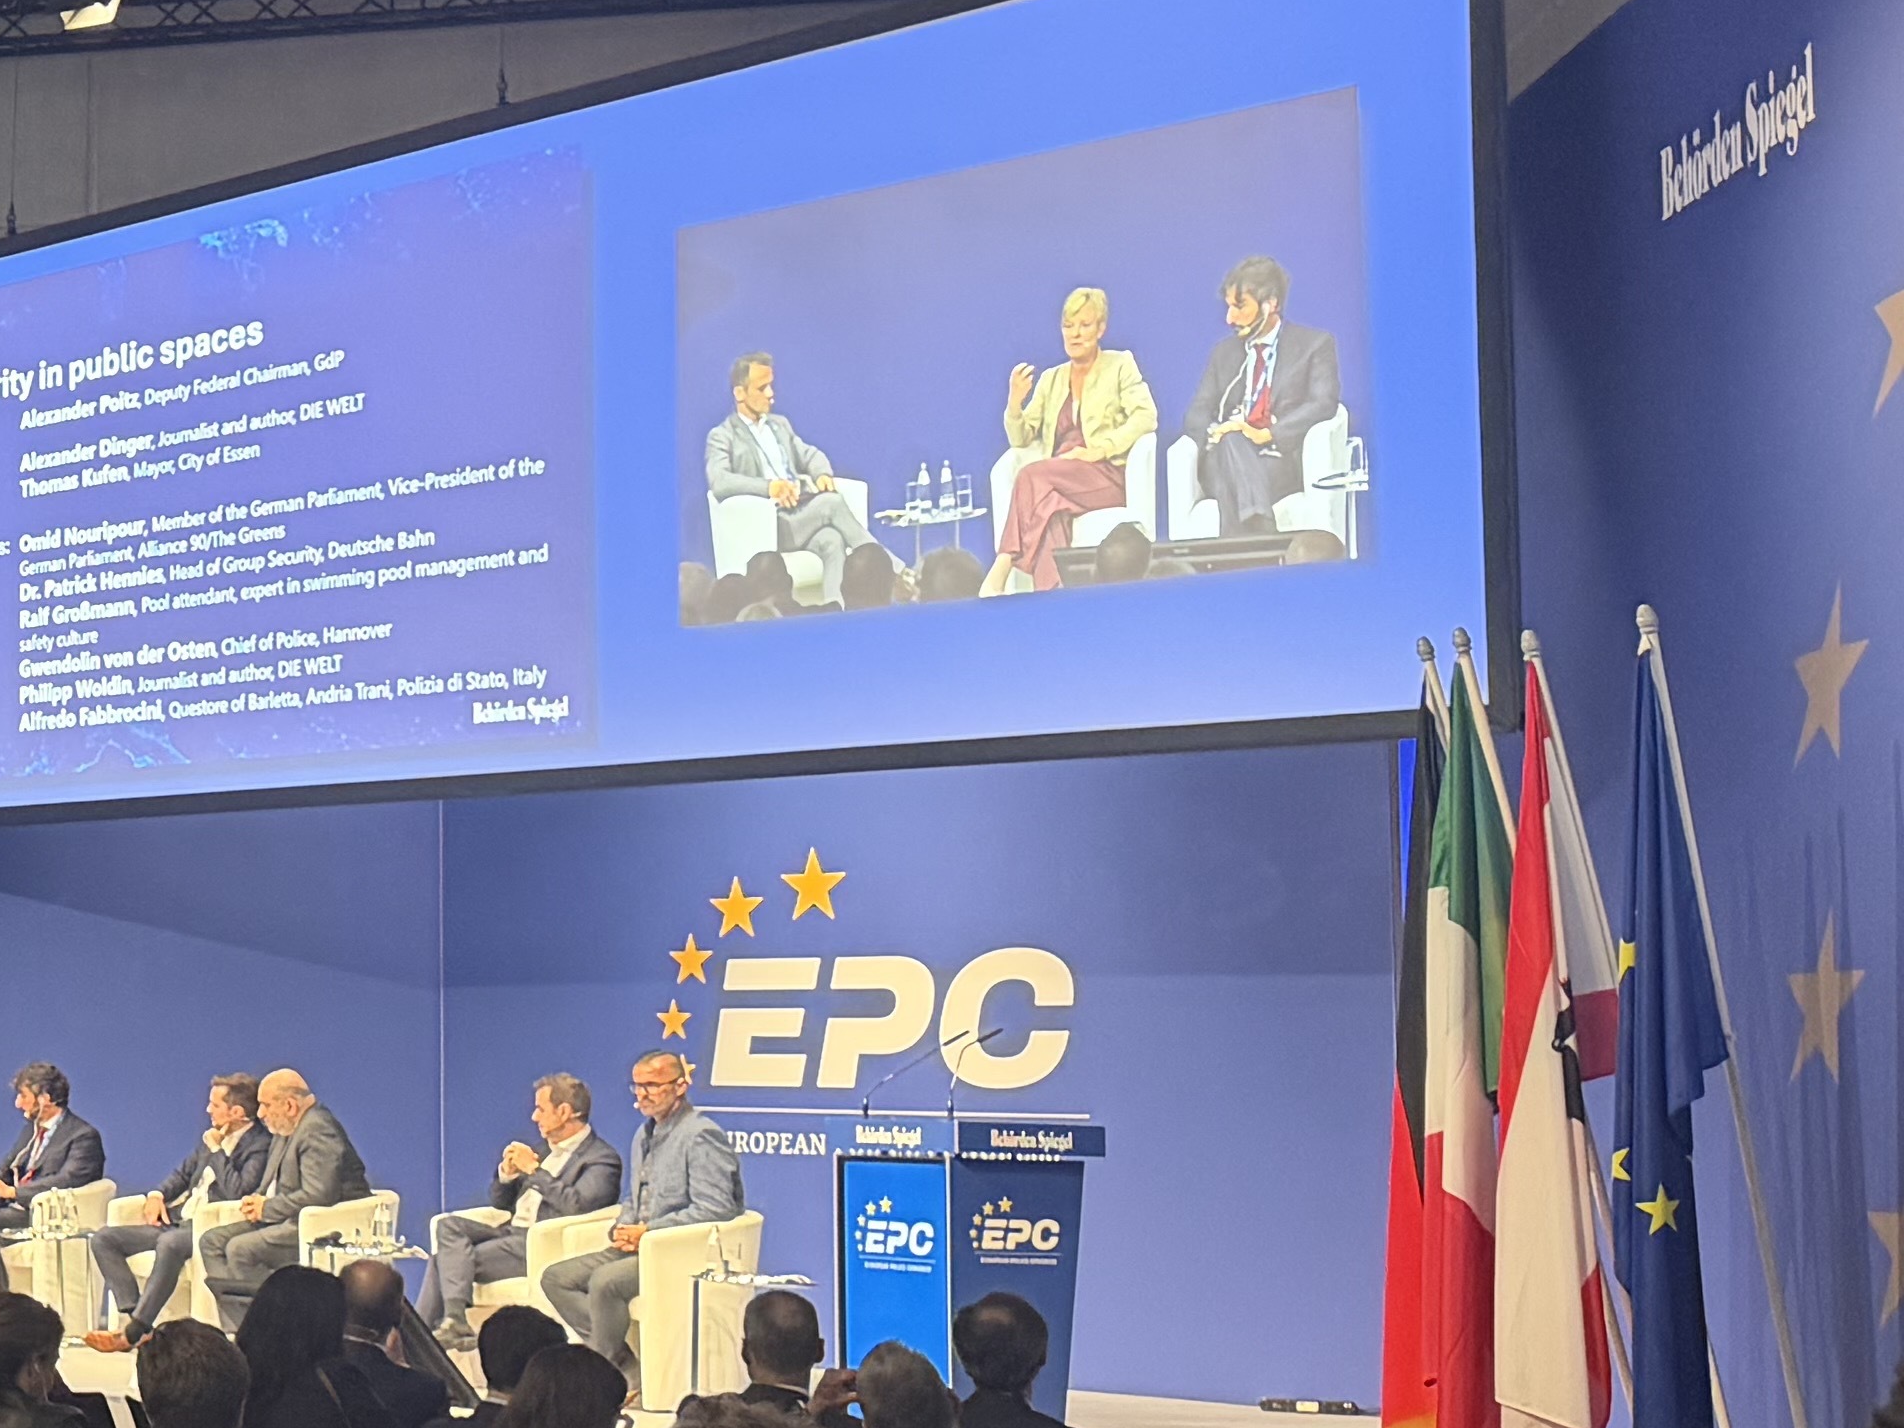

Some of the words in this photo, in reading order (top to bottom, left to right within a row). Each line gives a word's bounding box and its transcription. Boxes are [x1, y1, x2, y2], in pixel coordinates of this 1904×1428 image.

[1660, 110, 1744, 221] Behörden
[1745, 42, 1816, 177] Spiegel
[19, 398, 97, 431] Alexander
[144, 383, 191, 408] Deputy
[193, 369, 241, 397] Federal
[243, 360, 312, 387] Chairman,
[313, 348, 345, 373] GdP
[39, 359, 63, 391] in
[68, 340, 154, 392] public
[159, 320, 264, 370] spaces
[19, 442, 97, 474] Alexander
[99, 433, 156, 459] Dinger,
[157, 420, 220, 449] Journalist
[221, 414, 248, 437] and
[299, 399, 324, 422] DIE
[325, 392, 366, 416] WELT
[19, 474, 80, 499] Thomas
[81, 463, 131, 488] Kufen,
[178, 451, 205, 473] City
[205, 446, 221, 467] of
[223, 443, 261, 465] Essen
[19, 527, 62, 554] Omid
[151, 510, 207, 534] Member
[208, 503, 224, 525] of
[225, 502, 249, 523] the
[250, 495, 305, 519] German
[307, 480, 385, 510] Parliament,
[387, 464, 496, 497] Vice-President
[498, 457, 516, 481] of
[518, 455, 546, 478] the
[19, 557, 67, 578] German
[68, 544, 136, 570] Parliament,
[137, 538, 188, 560] Alliance
[190, 528, 237, 553] 90/The
[238, 524, 286, 545] Greens
[19, 581, 42, 604] Dr.
[43, 571, 98, 600] Patrick
[99, 564, 167, 592] Hennies,
[169, 558, 204, 582] Head
[206, 556, 222, 578] of
[222, 554, 266, 575] Group
[267, 544, 325, 570] Security,
[327, 533, 395, 561] Deutsche
[397, 527, 436, 551] Bahn
[19, 605, 51, 631] Ralf
[52, 598, 138, 625] Großmann,
[141, 591, 170, 614] Pool
[171, 585, 239, 610] attendant,
[240, 579, 285, 603] expert
[286, 579, 301, 595] in
[303, 567, 375, 594] swimming
[378, 558, 413, 588] pool
[415, 548, 516, 579] management
[518, 542, 549, 566] and
[19, 632, 55, 654] safety
[56, 629, 99, 648] culture
[19, 649, 101, 680] Gwendolin
[103, 650, 134, 669] von
[136, 642, 166, 666] der
[167, 639, 219, 662] Osten,
[221, 633, 257, 657] Chief
[258, 630, 274, 653] of
[276, 628, 321, 650] Police,
[322, 622, 393, 645] Hannover
[19, 681, 73, 708] Philipp
[137, 670, 199, 694] Journalist
[200, 665, 226, 688] and
[277, 657, 302, 679] DIE
[303, 653, 344, 677] WELT
[19, 706, 77, 734] Alfredo
[79, 698, 166, 727] Fabbrocini,
[168, 698, 229, 720] Questore
[230, 691, 246, 714] of
[248, 689, 304, 712] Barletta,
[305, 683, 353, 706] Andria
[354, 678, 394, 702] Trani,
[397, 673, 444, 698] Polizia
[447, 671, 463, 692] di
[465, 670, 509, 692] Stato,
[512, 664, 548, 691] Italy
[709, 947, 1075, 1090] EPC
[726, 1131, 827, 1156] ROPEAN
[864, 1219, 936, 1257] EPC
[980, 1217, 1061, 1252] EPC
